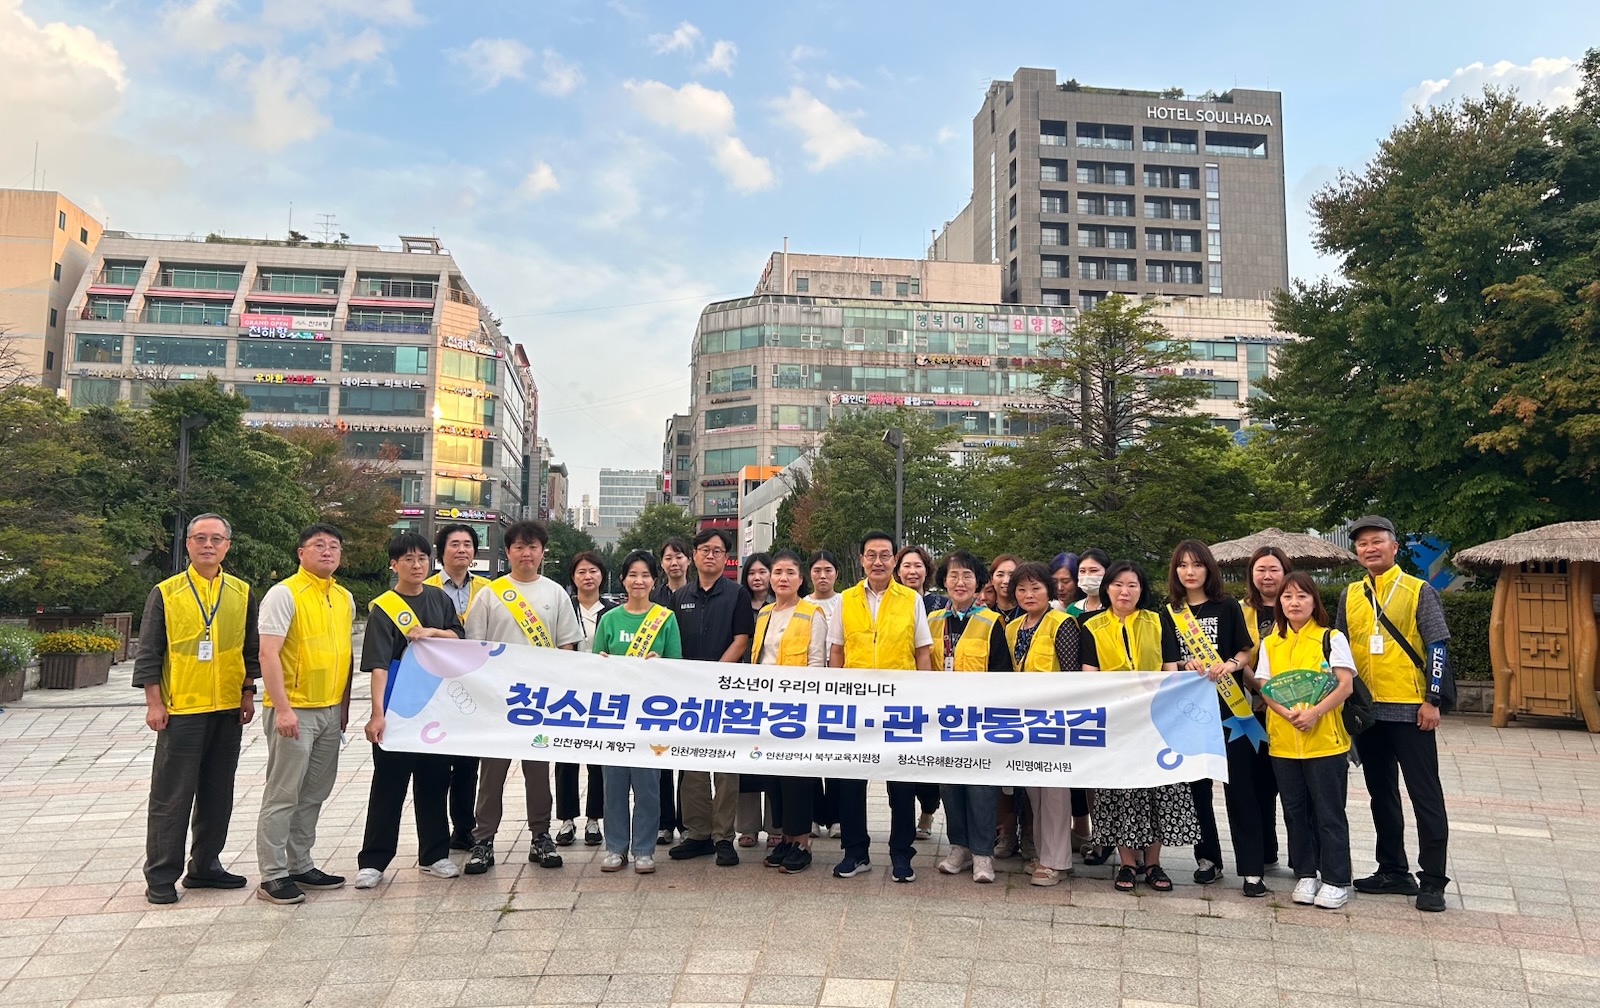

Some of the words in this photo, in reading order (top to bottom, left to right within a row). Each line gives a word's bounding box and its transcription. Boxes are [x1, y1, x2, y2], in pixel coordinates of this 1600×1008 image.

[1147, 106, 1193, 121] HOTEL
[1196, 109, 1273, 127] SOULHADA
[916, 313, 984, 330] 행복여정
[248, 326, 288, 339] 천해향
[255, 373, 284, 384] 우아한
[341, 376, 379, 388] 테이스트
[383, 378, 422, 389] 피트니스
[718, 675, 774, 693] 청소년이
[778, 679, 820, 695] 우리의
[825, 681, 896, 697] 미래입니다
[506, 682, 631, 730] 청소년
[635, 694, 808, 739] 유해환경
[937, 704, 1107, 747] 합동점검
[553, 737, 603, 751] 인천광역시
[605, 740, 636, 753] 계양구
[671, 746, 736, 760] 인천계양경찰서
[765, 751, 812, 762] 인천광역시
[814, 753, 881, 764] 북부교육지원청
[897, 754, 992, 770] 청소년유해환경감시단
[1005, 759, 1073, 773] 시민명예감시원
